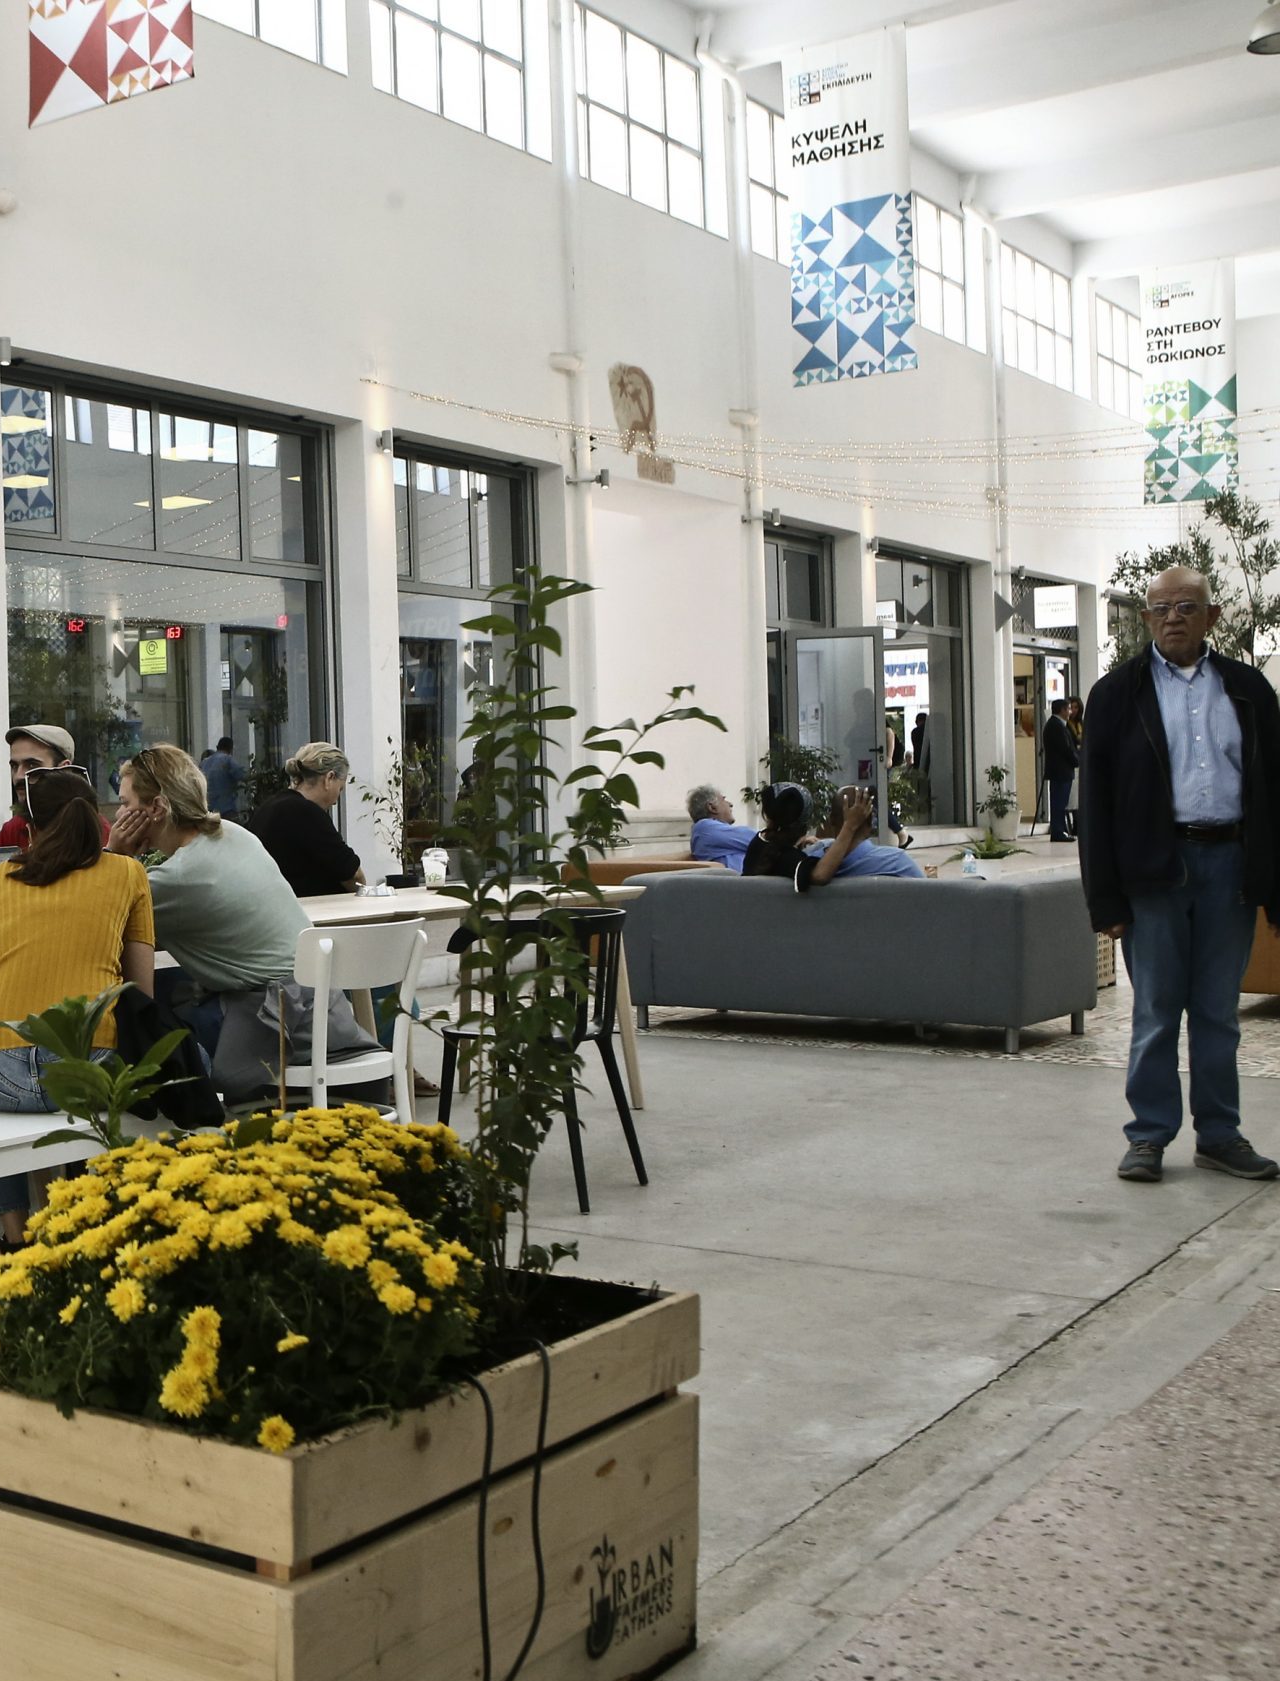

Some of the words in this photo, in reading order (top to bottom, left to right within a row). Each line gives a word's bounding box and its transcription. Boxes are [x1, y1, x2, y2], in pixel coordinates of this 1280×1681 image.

[822, 72, 872, 91] ΕΚΠΑΙΔΕΥΣΗ
[791, 119, 867, 149] ΚΥΨΕΛΗ
[792, 134, 885, 168] ΜΑΘΗΣΗΣ
[1146, 318, 1221, 338] ΡΑΝΤΕΒΟΥ
[1146, 344, 1226, 364] ΦΩΚΙΩΝΟΣ
[1147, 339, 1173, 351] ΣΤΗ
[68, 620, 84, 632] 162
[167, 627, 181, 639] 163
[621, 1593, 673, 1642] ATHENS
